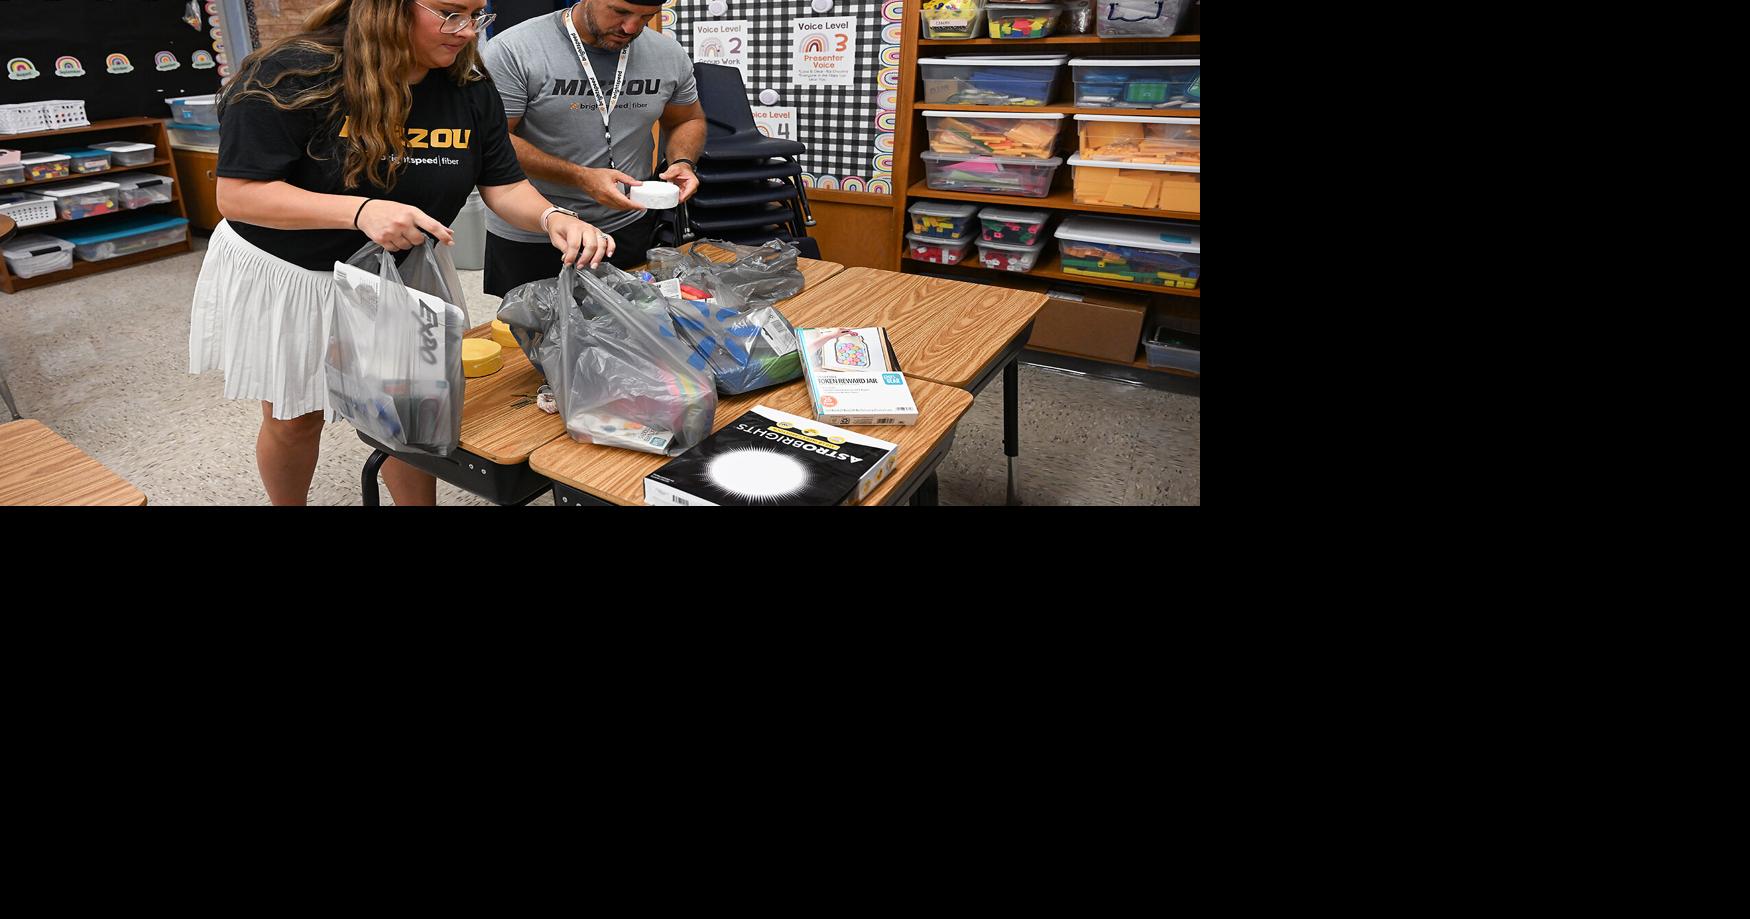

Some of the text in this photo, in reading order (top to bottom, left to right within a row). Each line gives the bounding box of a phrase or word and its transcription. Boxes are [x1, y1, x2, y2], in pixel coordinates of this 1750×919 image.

[825, 21, 849, 29] Level
[728, 37, 742, 54] 2
[834, 33, 848, 51] 3
[778, 123, 789, 139] 4
[736, 423, 863, 463] ASTROBRIGHTS
